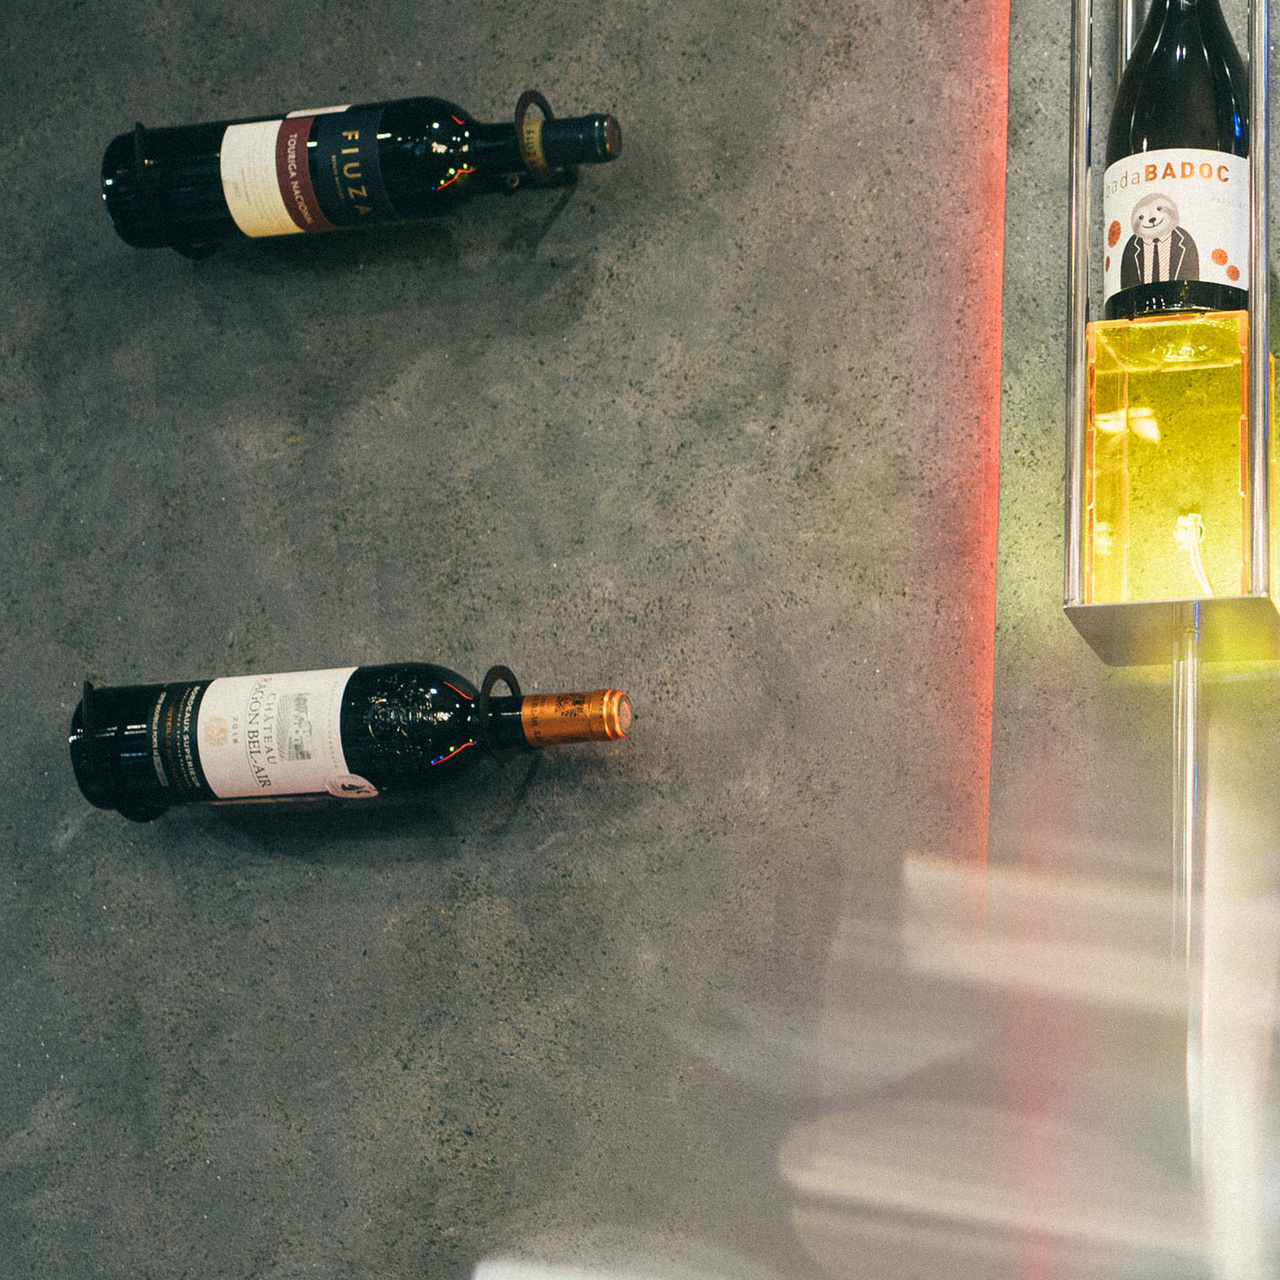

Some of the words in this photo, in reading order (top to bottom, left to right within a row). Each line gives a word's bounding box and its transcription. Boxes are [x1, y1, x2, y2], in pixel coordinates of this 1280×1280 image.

[287, 133, 298, 178] TOURIGA
[341, 129, 372, 217] FIUZA
[183, 685, 201, 732] BORDEAUX
[247, 730, 272, 788] BEL-AIR
